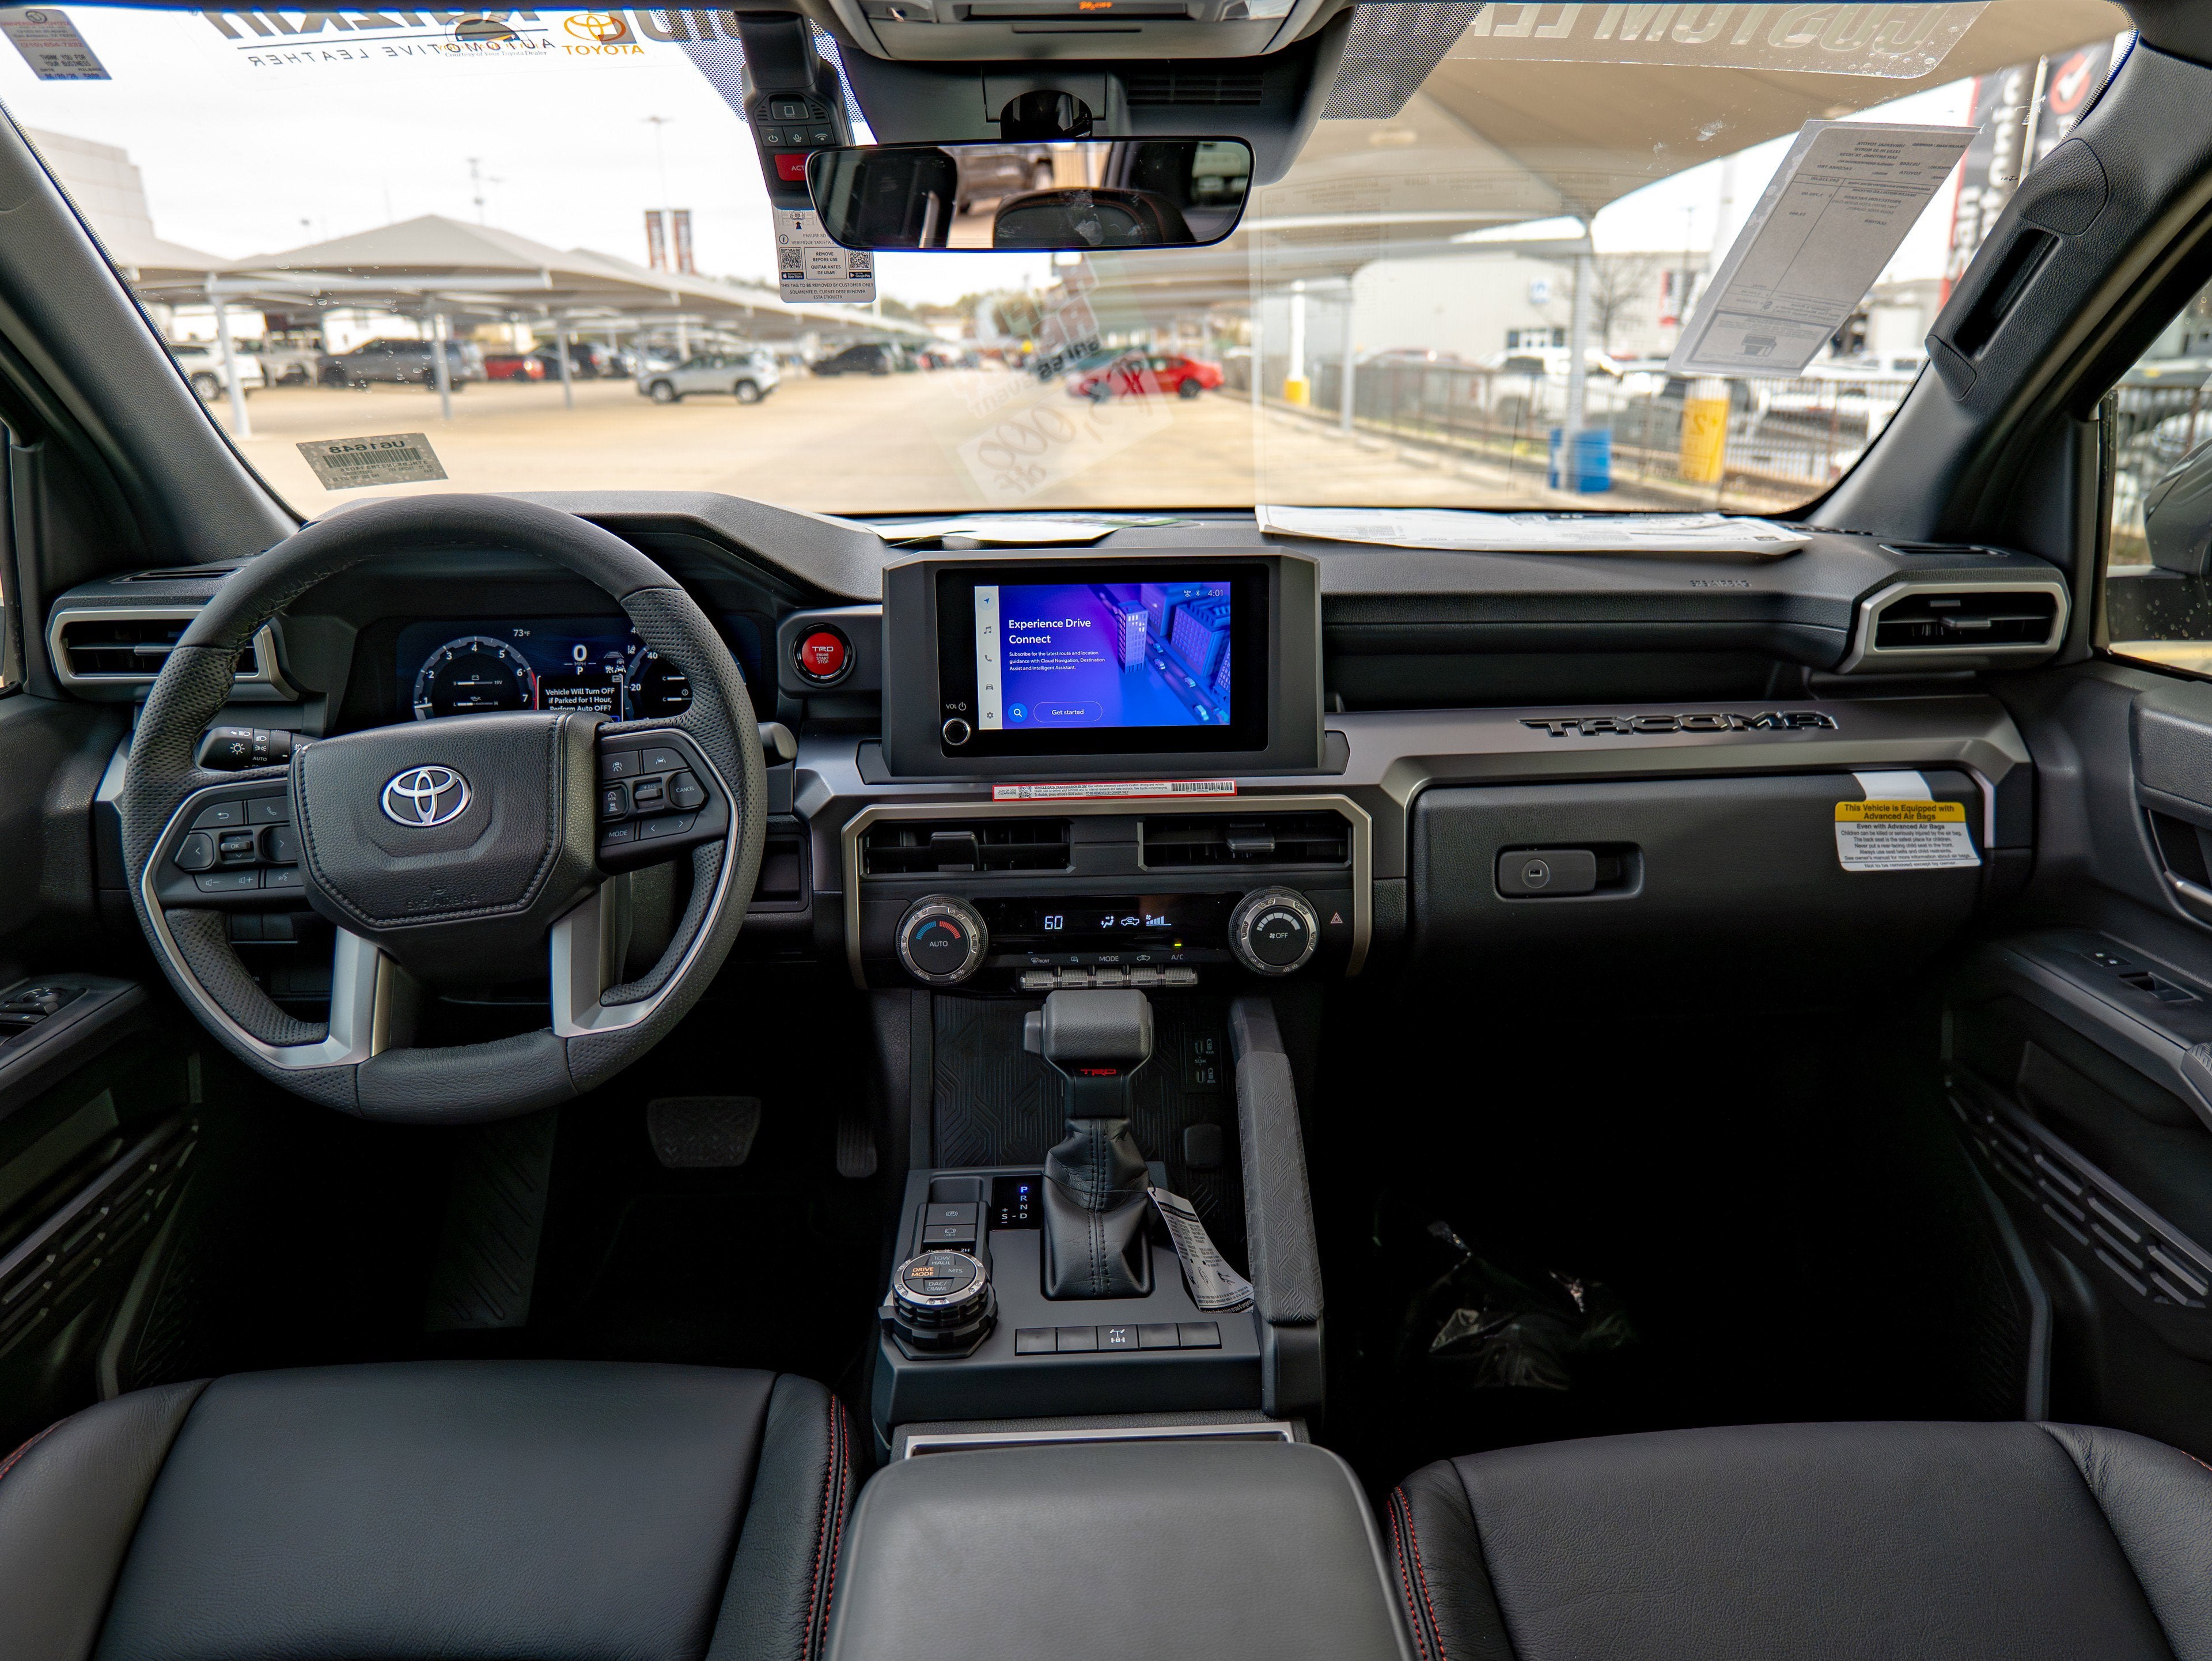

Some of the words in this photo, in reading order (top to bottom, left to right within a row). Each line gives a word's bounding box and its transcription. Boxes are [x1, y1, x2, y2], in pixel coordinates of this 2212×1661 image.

[562, 45, 644, 55] TOYOTA
[1208, 589, 1224, 597] 4:01
[1009, 619, 1063, 630] Experience
[1066, 619, 1091, 627] Drive
[1009, 635, 1051, 644] Connect
[499, 650, 505, 659] 5
[572, 644, 588, 661] 0
[429, 671, 434, 679] 2
[517, 668, 522, 676] 6
[577, 667, 584, 675] P
[522, 694, 528, 702] 7
[1515, 710, 1839, 737] TACOMA
[1901, 804, 1937, 814] Equipped
[1044, 916, 1063, 929] 60
